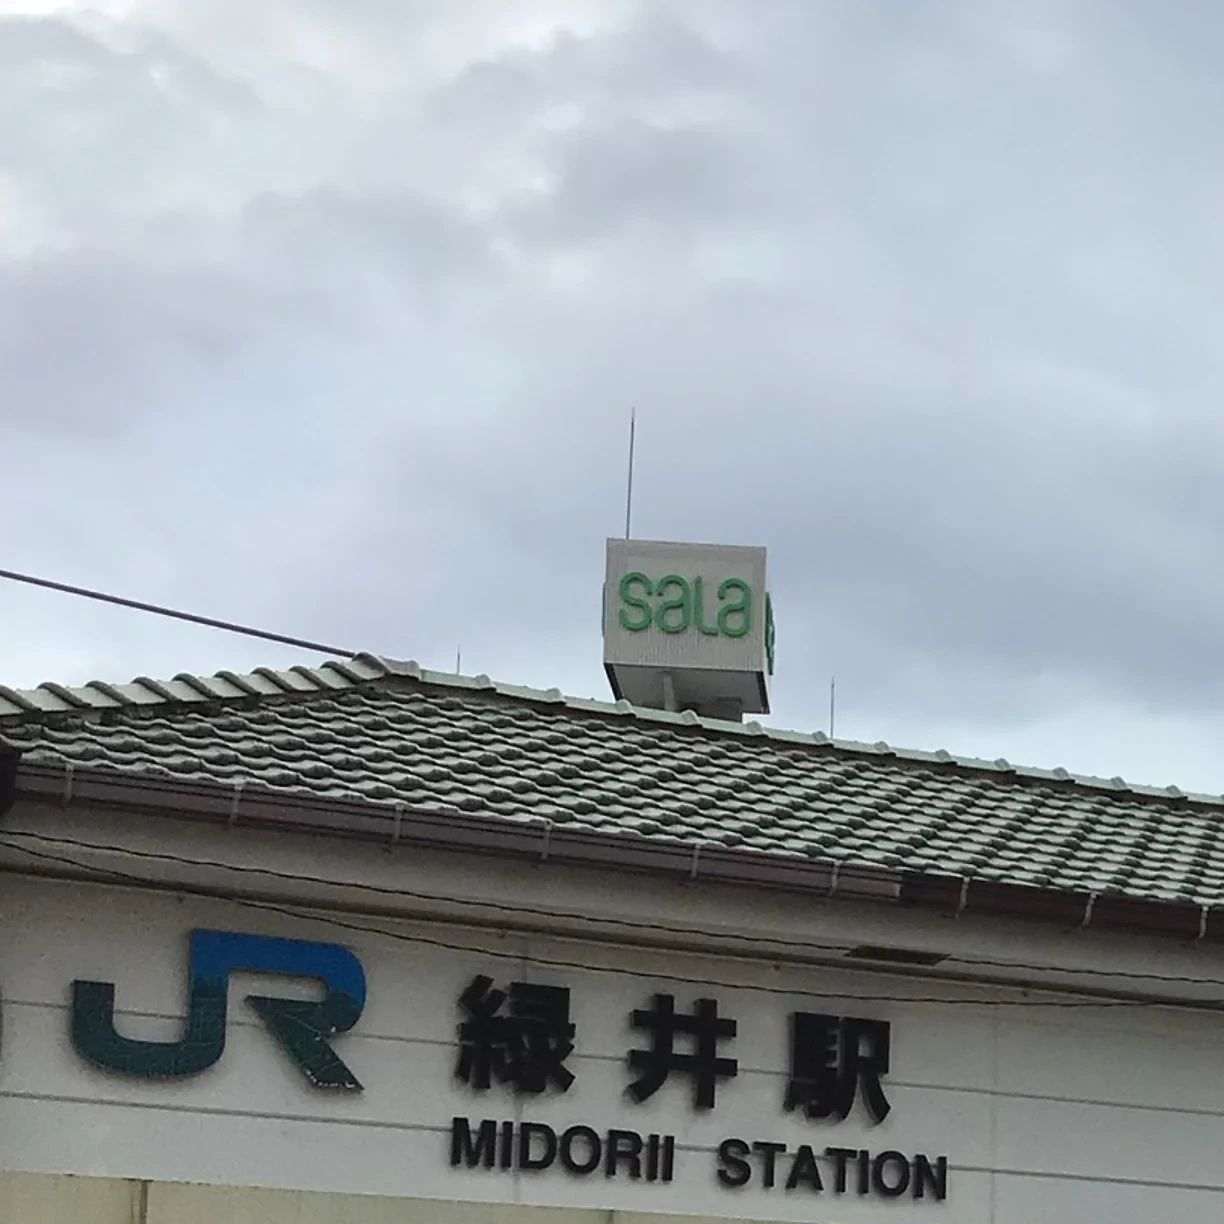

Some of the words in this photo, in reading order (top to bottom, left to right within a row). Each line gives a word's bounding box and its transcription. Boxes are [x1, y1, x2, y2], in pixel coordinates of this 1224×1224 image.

[72, 929, 367, 1093] JR
[456, 974, 892, 1125] 緑井駅
[452, 1115, 674, 1181] MIDORII
[717, 1138, 948, 1200] STATION
